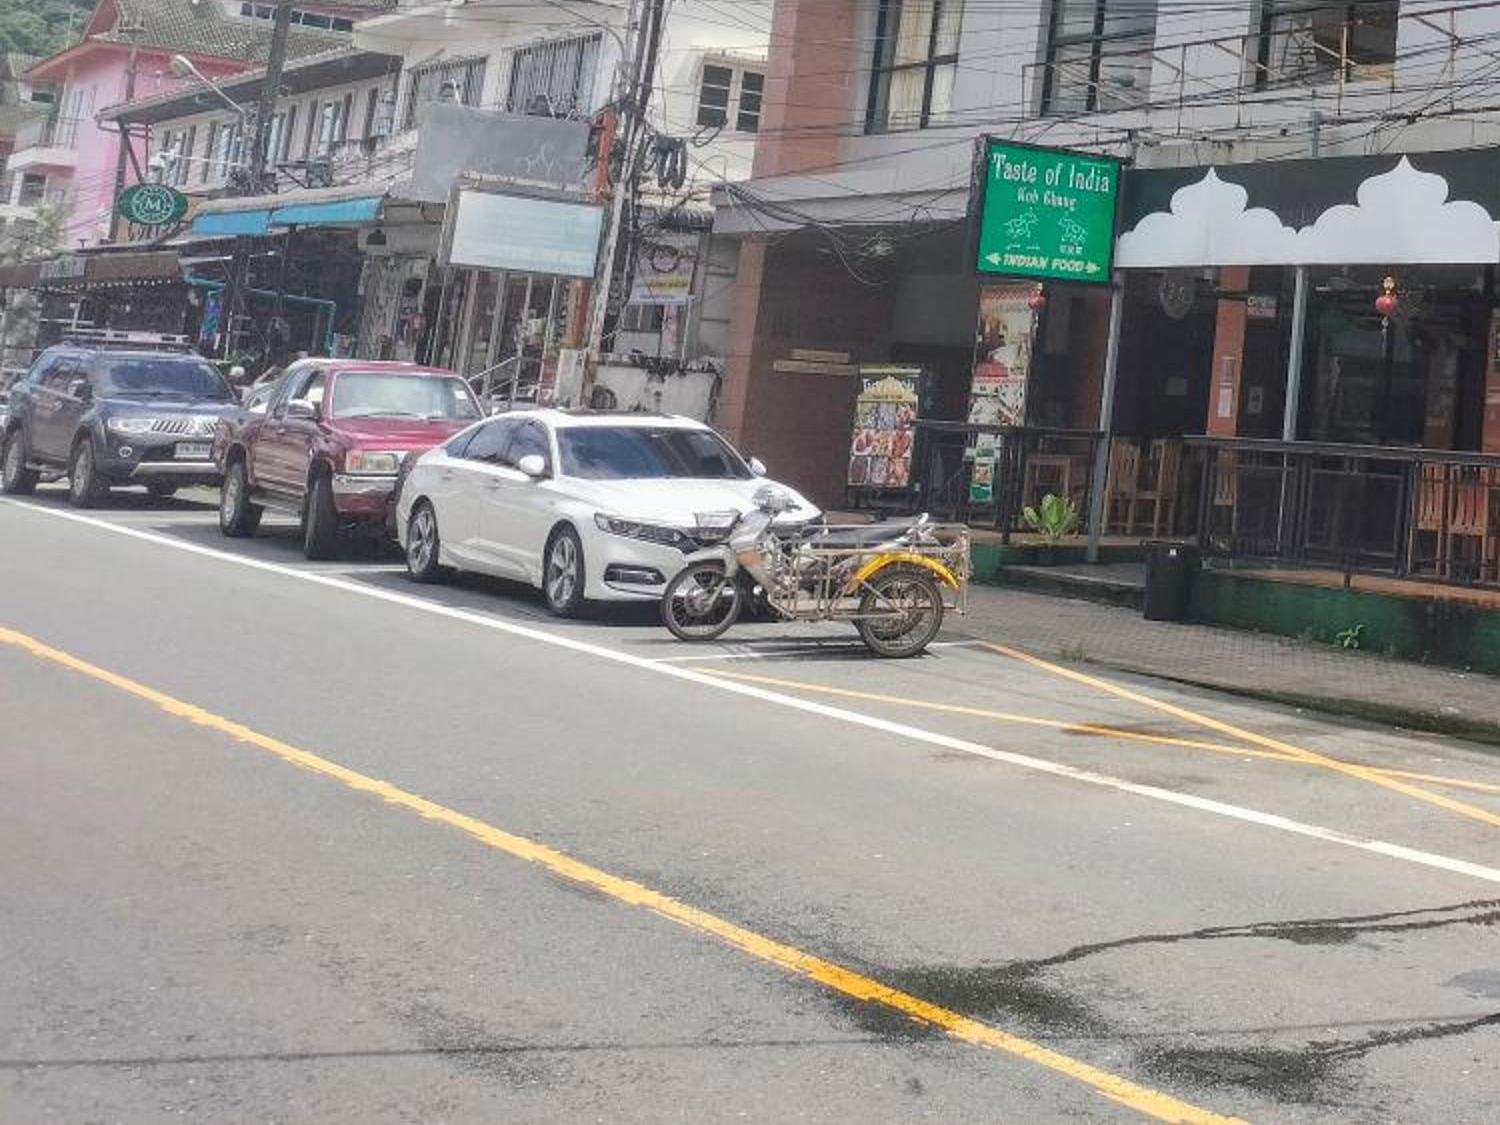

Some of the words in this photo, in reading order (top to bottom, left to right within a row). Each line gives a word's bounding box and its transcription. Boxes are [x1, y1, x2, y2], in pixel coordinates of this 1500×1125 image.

[992, 152, 1037, 183] Taste
[1045, 162, 1064, 186] of
[1069, 164, 1110, 193] India
[1003, 253, 1049, 270] INDIAN
[1051, 258, 1085, 273] FOOD
